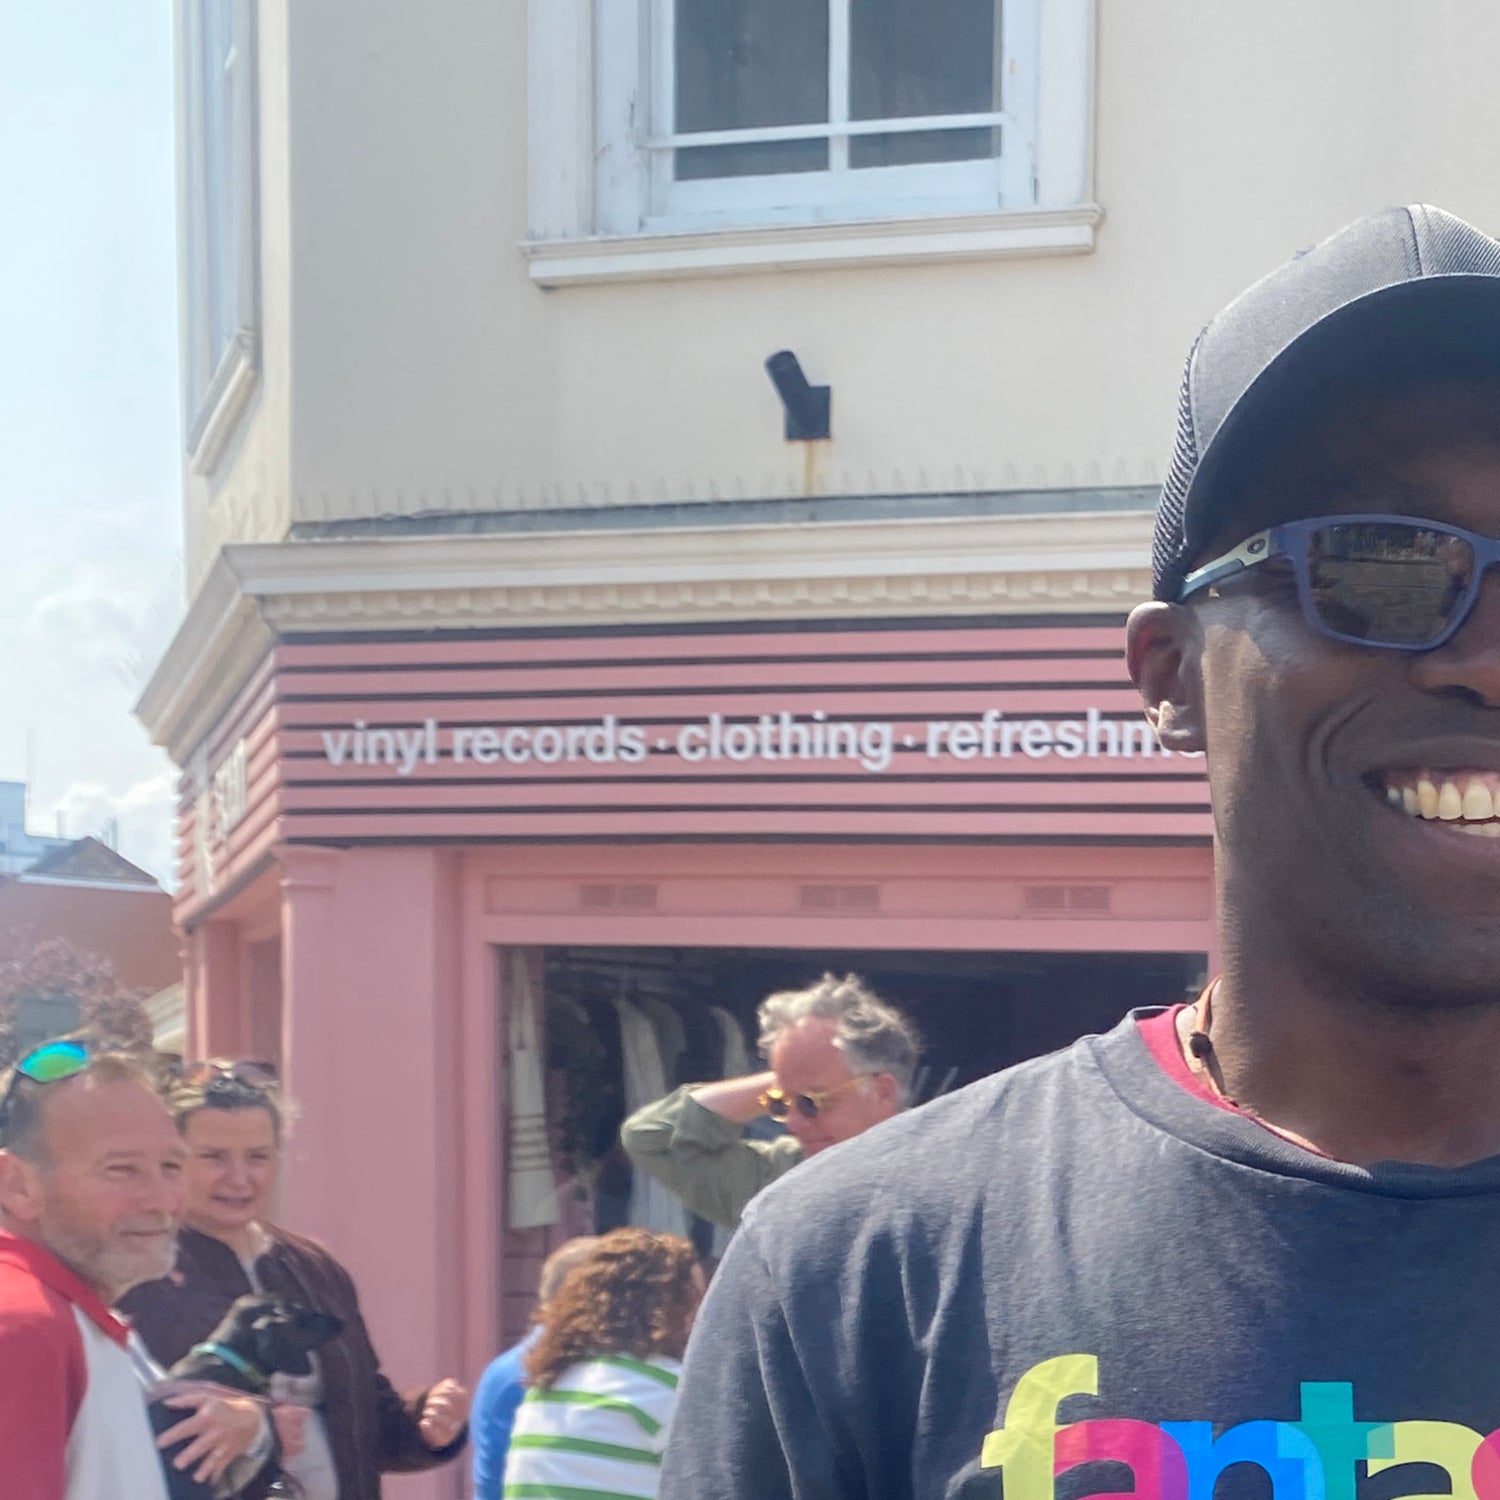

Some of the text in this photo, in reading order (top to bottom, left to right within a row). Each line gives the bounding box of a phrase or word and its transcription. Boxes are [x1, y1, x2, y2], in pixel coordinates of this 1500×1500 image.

[321, 708, 1206, 776] vinyl records clothing refreshm
